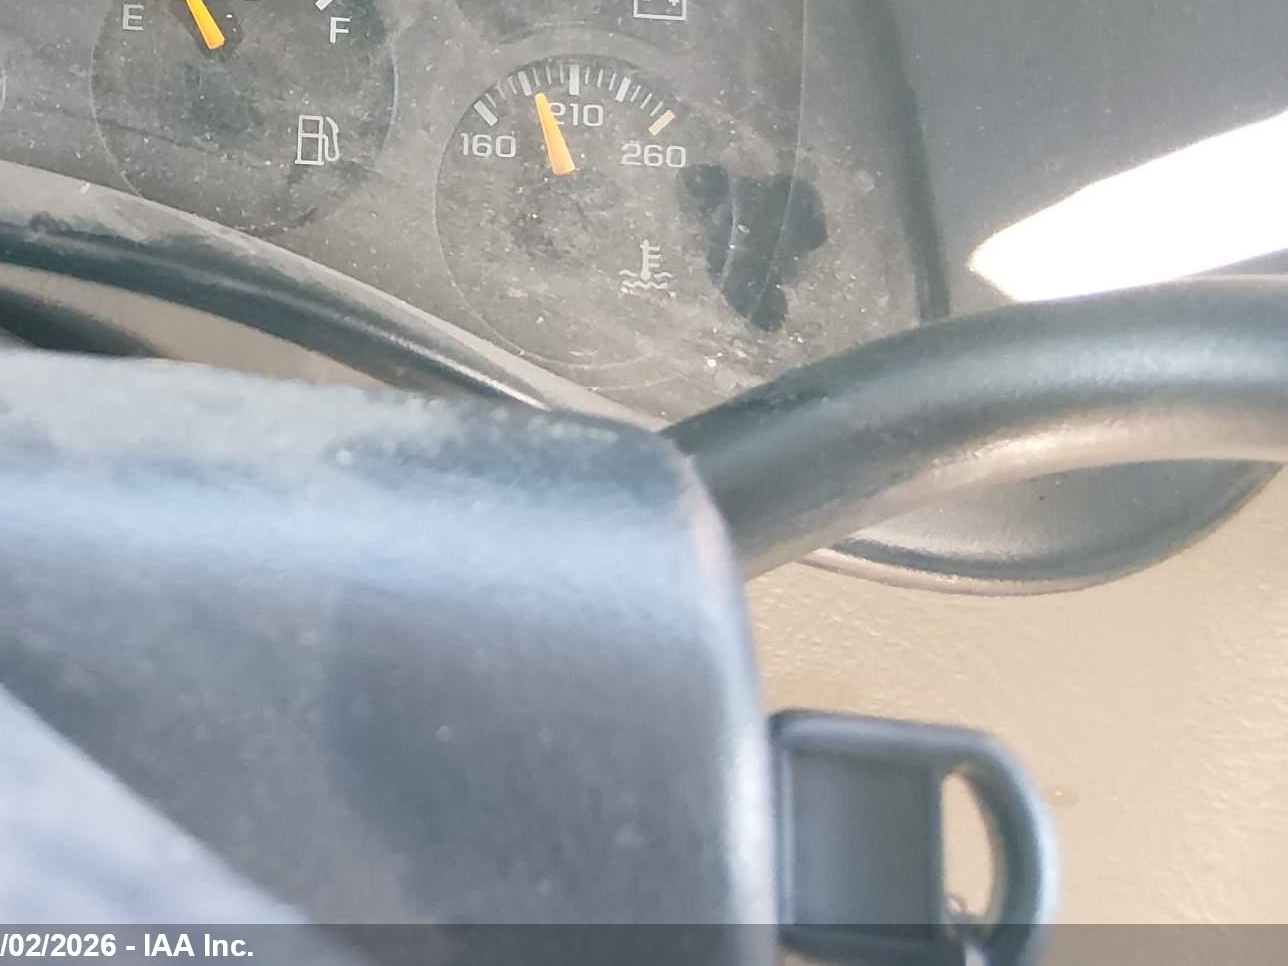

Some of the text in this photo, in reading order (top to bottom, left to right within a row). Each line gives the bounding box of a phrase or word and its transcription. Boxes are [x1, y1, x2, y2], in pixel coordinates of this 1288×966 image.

[122, 4, 145, 31] E
[329, 16, 351, 44] F
[548, 101, 604, 126] 210
[460, 132, 517, 160] 160
[619, 140, 687, 168] 260
